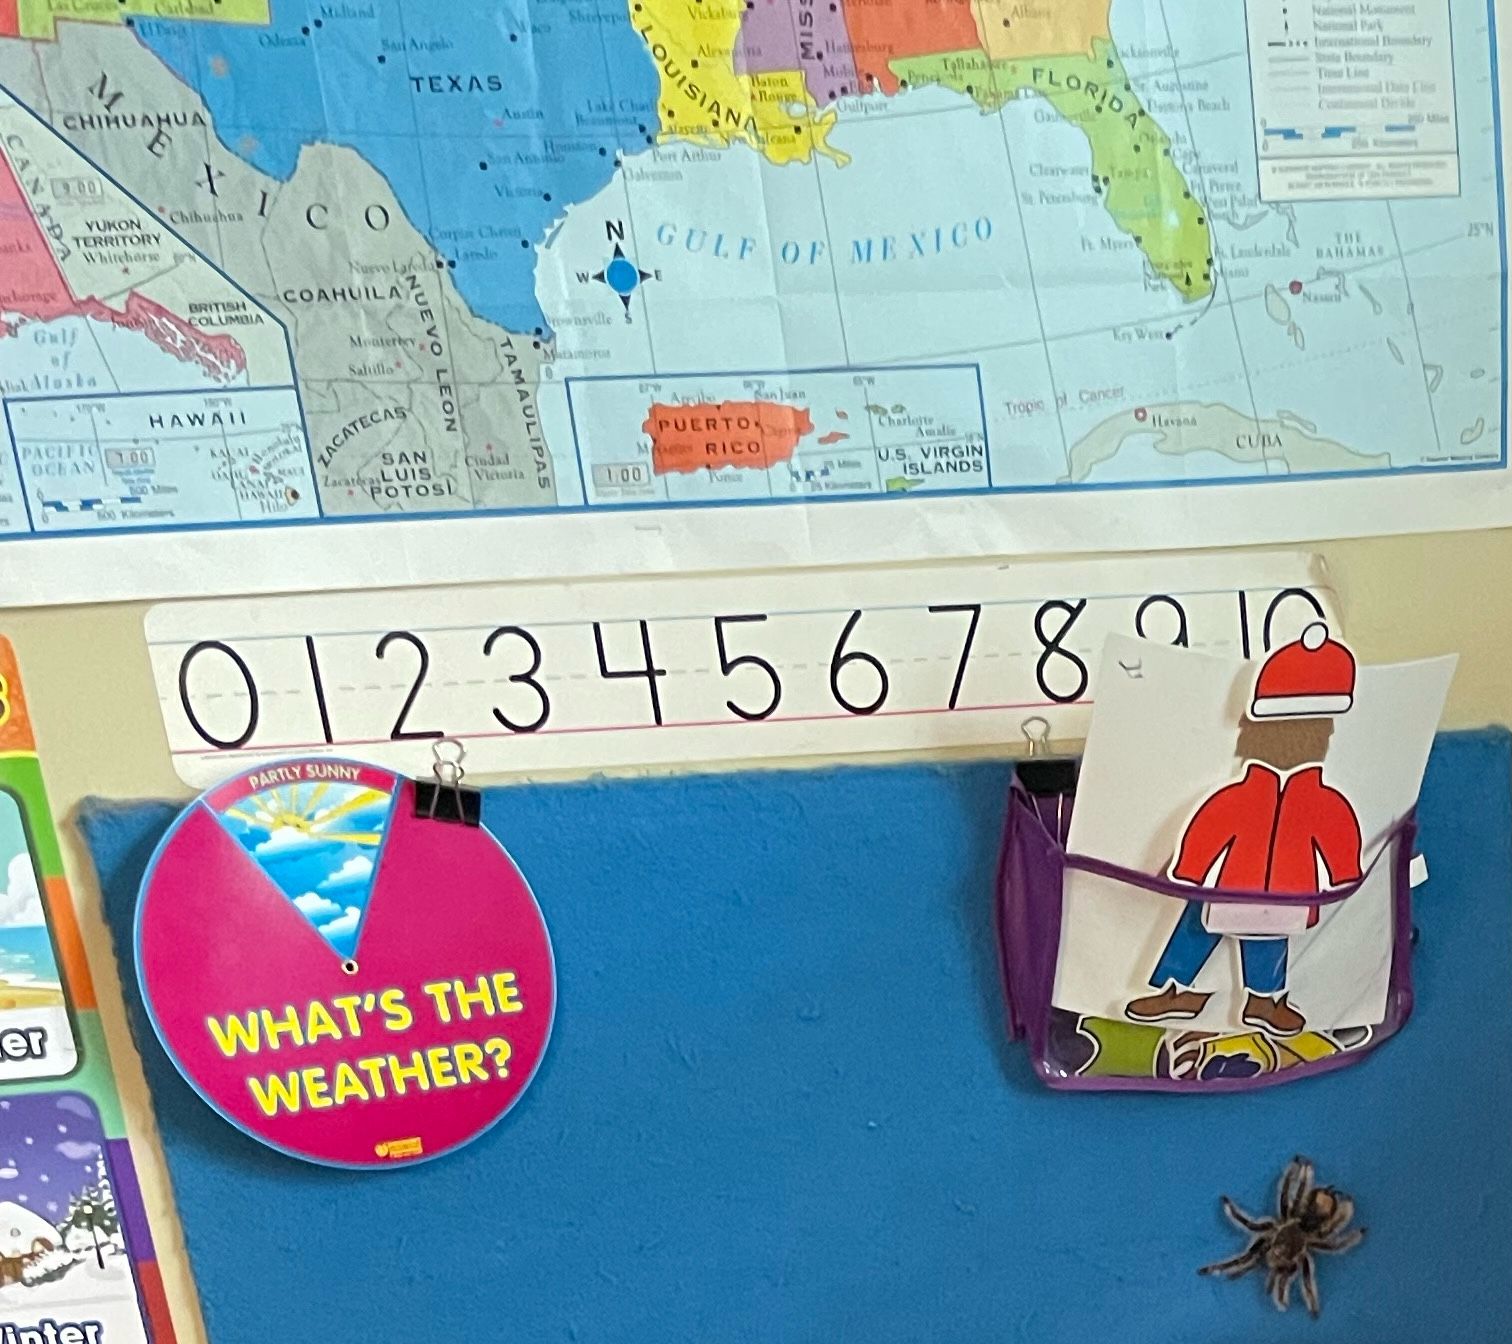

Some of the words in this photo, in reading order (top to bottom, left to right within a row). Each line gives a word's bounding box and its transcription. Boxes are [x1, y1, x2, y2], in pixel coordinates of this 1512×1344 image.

[799, 0, 814, 61] MIS
[409, 75, 504, 94] TEXAS
[641, 25, 760, 134] LOUISIANA
[1032, 66, 1139, 130] FLORIDA
[62, 110, 207, 131] CHIHUAHUA
[85, 218, 142, 234] YUKON
[604, 219, 625, 242] N
[72, 233, 162, 248] TERRITORY
[656, 222, 757, 261] GULF
[780, 240, 826, 267] OF
[851, 216, 993, 265] MEXICO
[575, 270, 590, 283] W
[654, 270, 663, 282] E
[283, 284, 402, 304] COAHUILA
[187, 301, 248, 314] BRITISH
[187, 313, 266, 327] COLUMBIA
[623, 312, 633, 325] S
[404, 273, 444, 358] NUEVO
[434, 367, 458, 434] LEON
[148, 410, 248, 430] HAWAII
[499, 335, 551, 491] TAMAULIPAS
[657, 417, 753, 434] PUERTO
[316, 406, 409, 469] ZACATECAS
[1235, 432, 1285, 450] CUBA
[381, 452, 428, 466] SAN
[704, 441, 762, 457] RICO
[920, 443, 985, 461] VIRGIN
[380, 466, 432, 482] LUIS
[902, 459, 984, 476] ISLANDS
[370, 479, 453, 499] POTOSI
[178, 641, 259, 750] 0
[305, 635, 333, 744] 1
[375, 631, 444, 740] 2
[483, 626, 550, 733] 3
[593, 619, 667, 726] 4
[714, 614, 782, 721] 5
[830, 609, 889, 716] 6
[928, 604, 981, 711] 7
[1034, 598, 1088, 704] 8
[247, 764, 302, 792] PARTLY
[303, 762, 362, 782] SUNNY
[206, 987, 415, 1059] WHAT'S
[423, 971, 524, 1025] THE
[0, 1027, 45, 1057] er
[248, 1037, 513, 1118] WEATHER?
